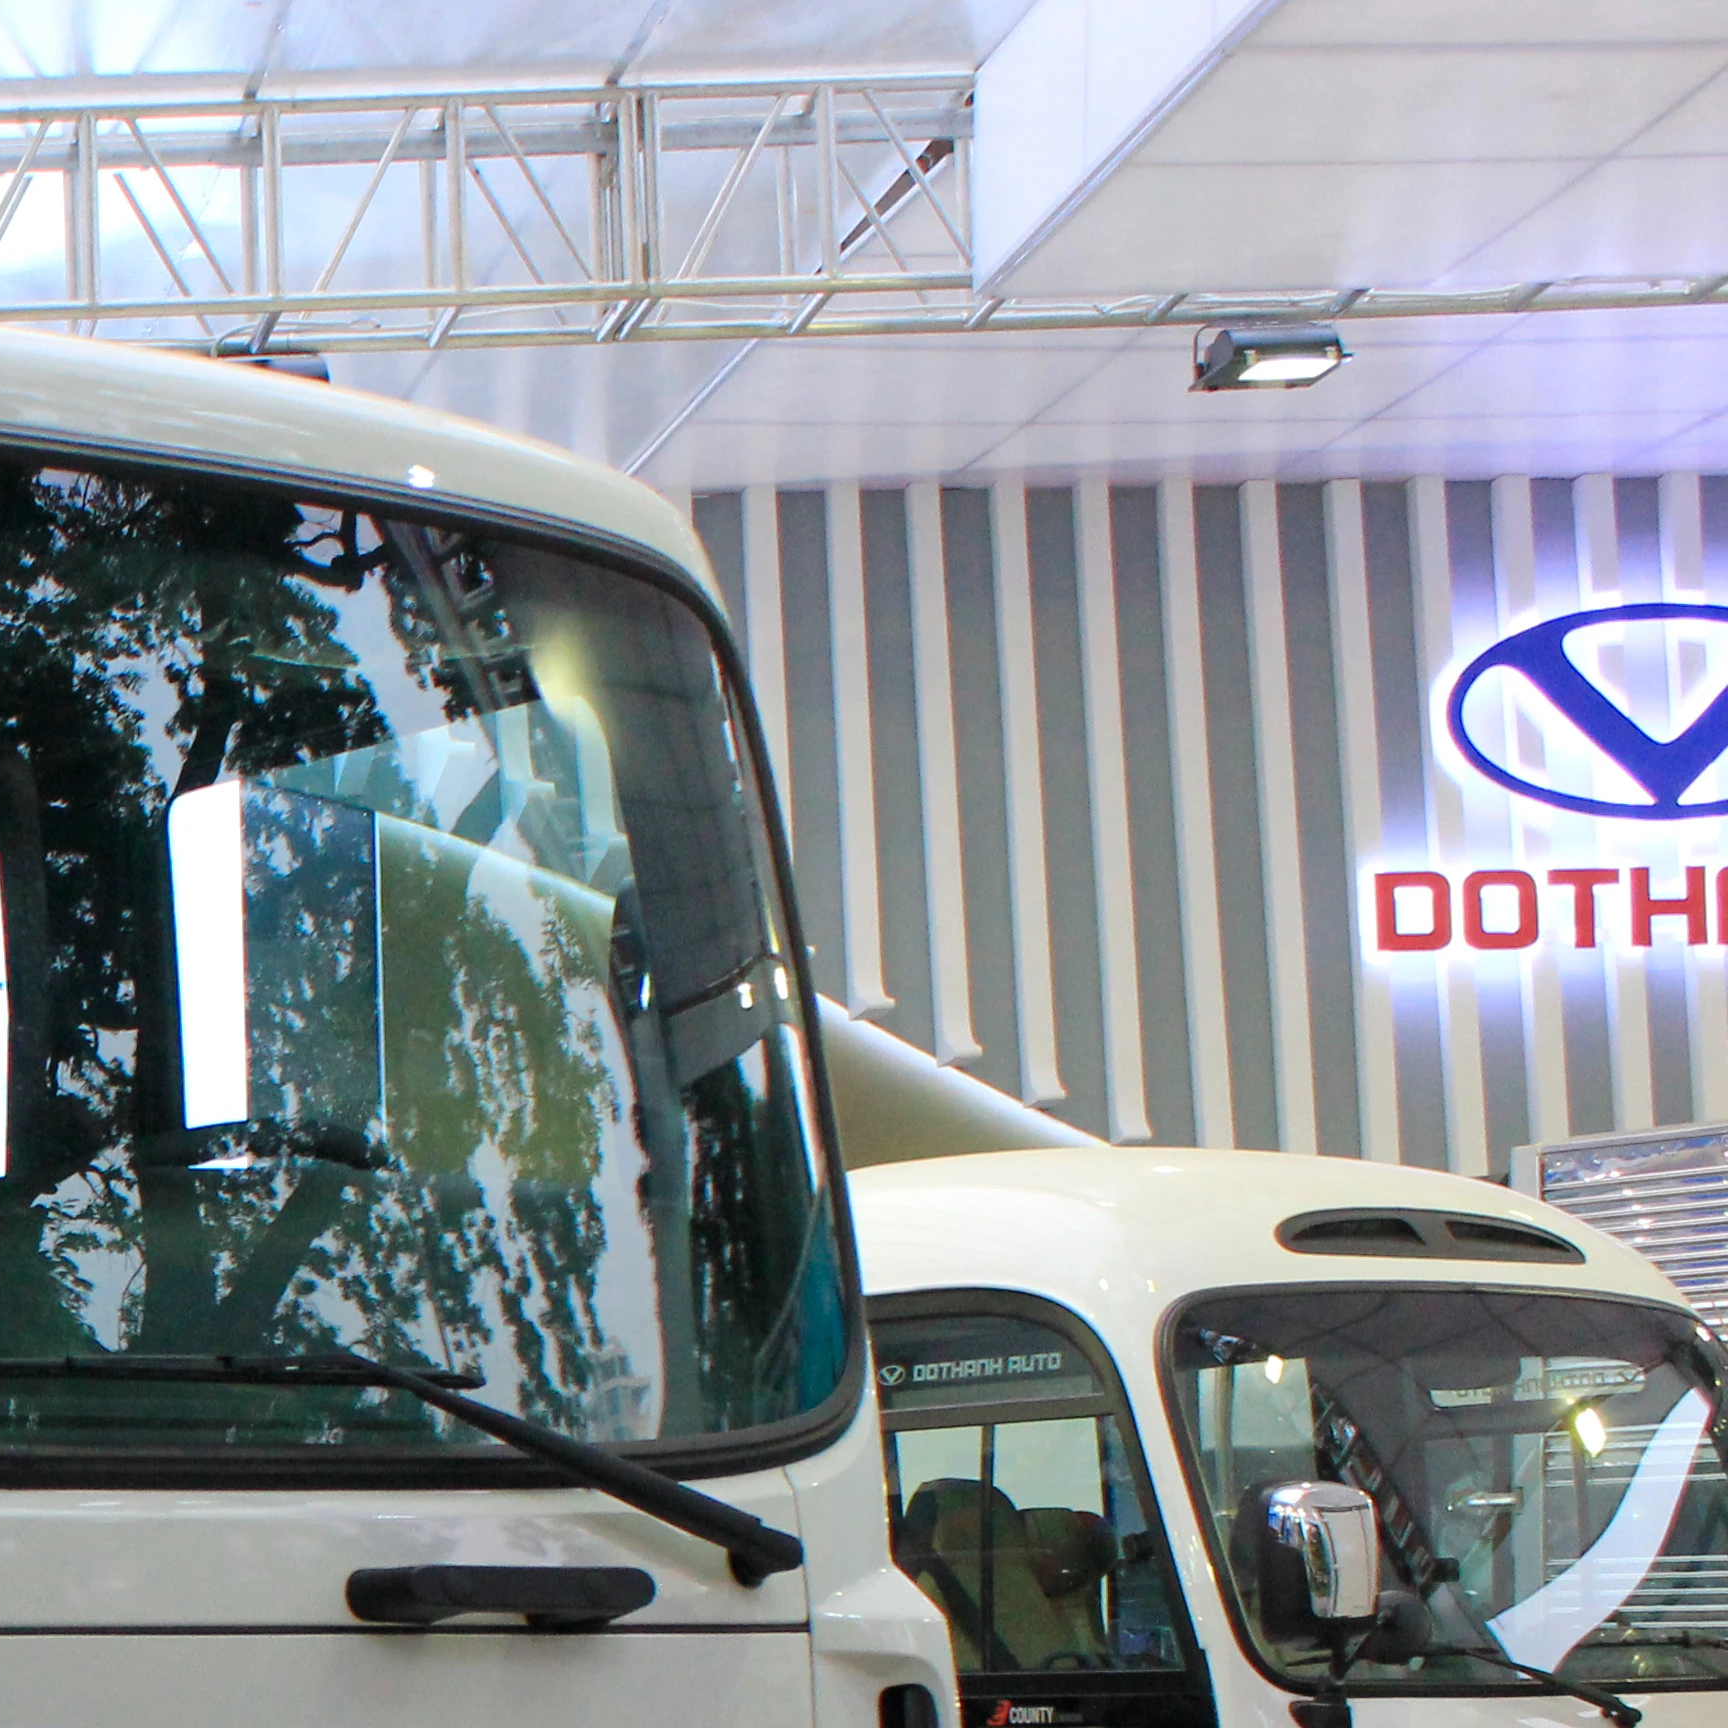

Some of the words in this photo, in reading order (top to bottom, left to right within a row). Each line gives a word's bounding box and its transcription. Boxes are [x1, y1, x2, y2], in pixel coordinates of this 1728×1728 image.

[1375, 866, 1728, 951] DOTH
[912, 1357, 1003, 1383] DOTHANH
[1007, 1351, 1062, 1374] AUTO
[1009, 1706, 1055, 1724] COUNTY
